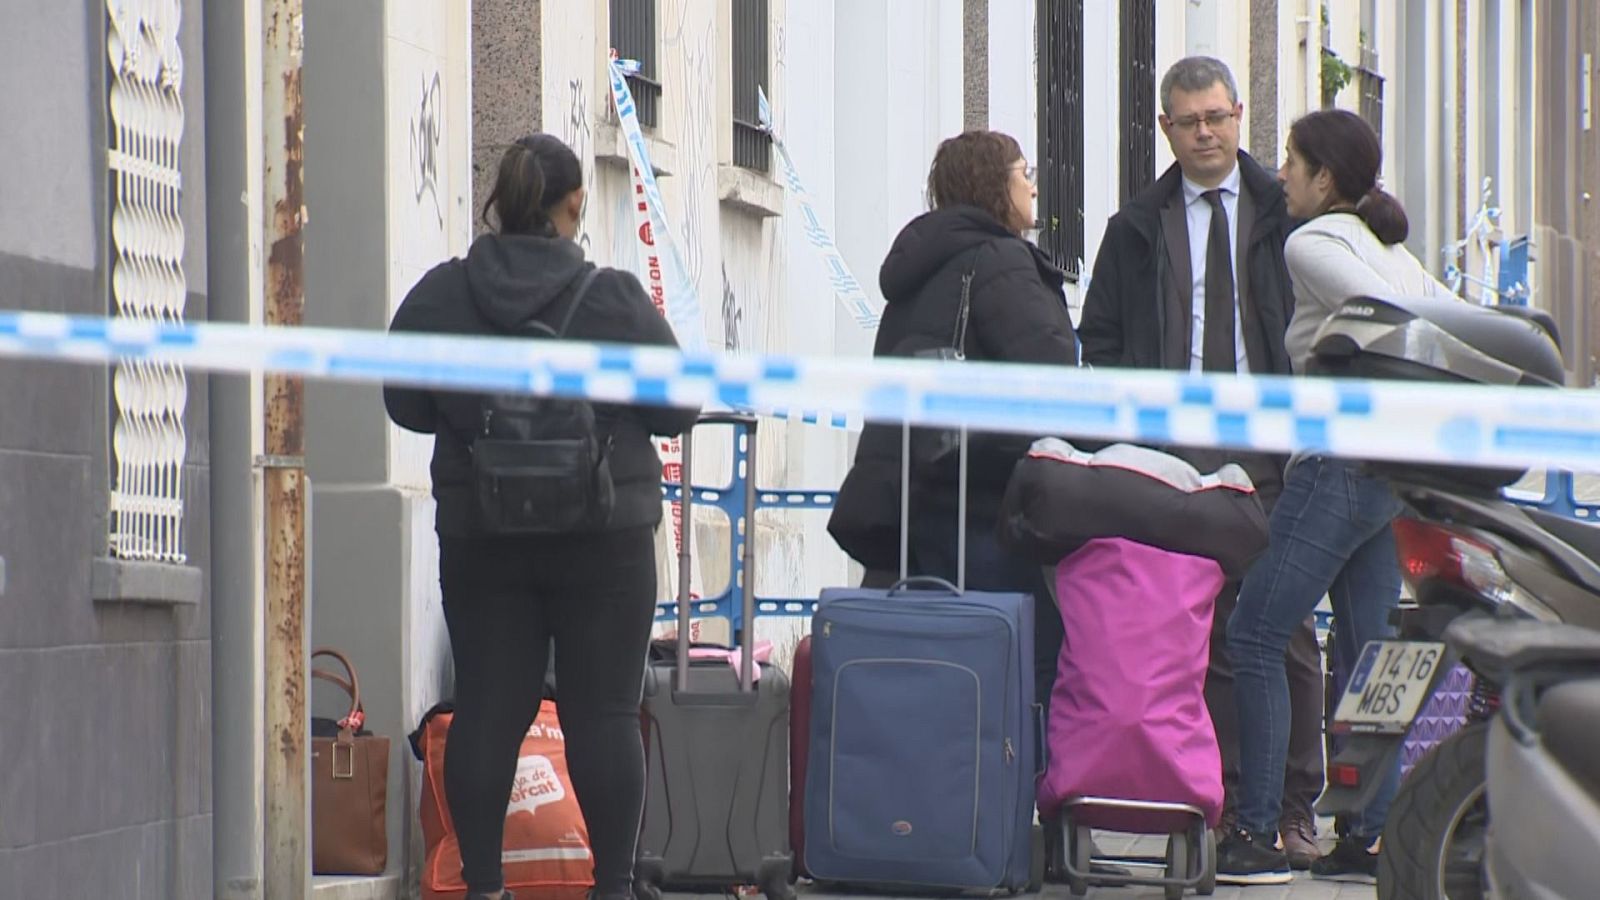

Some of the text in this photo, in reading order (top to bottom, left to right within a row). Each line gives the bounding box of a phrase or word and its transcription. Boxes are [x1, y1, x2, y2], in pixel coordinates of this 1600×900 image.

[648, 256, 661, 281] NO
[1378, 648, 1437, 681] 1416
[1356, 682, 1407, 715] MBS
[532, 769, 547, 781] de
